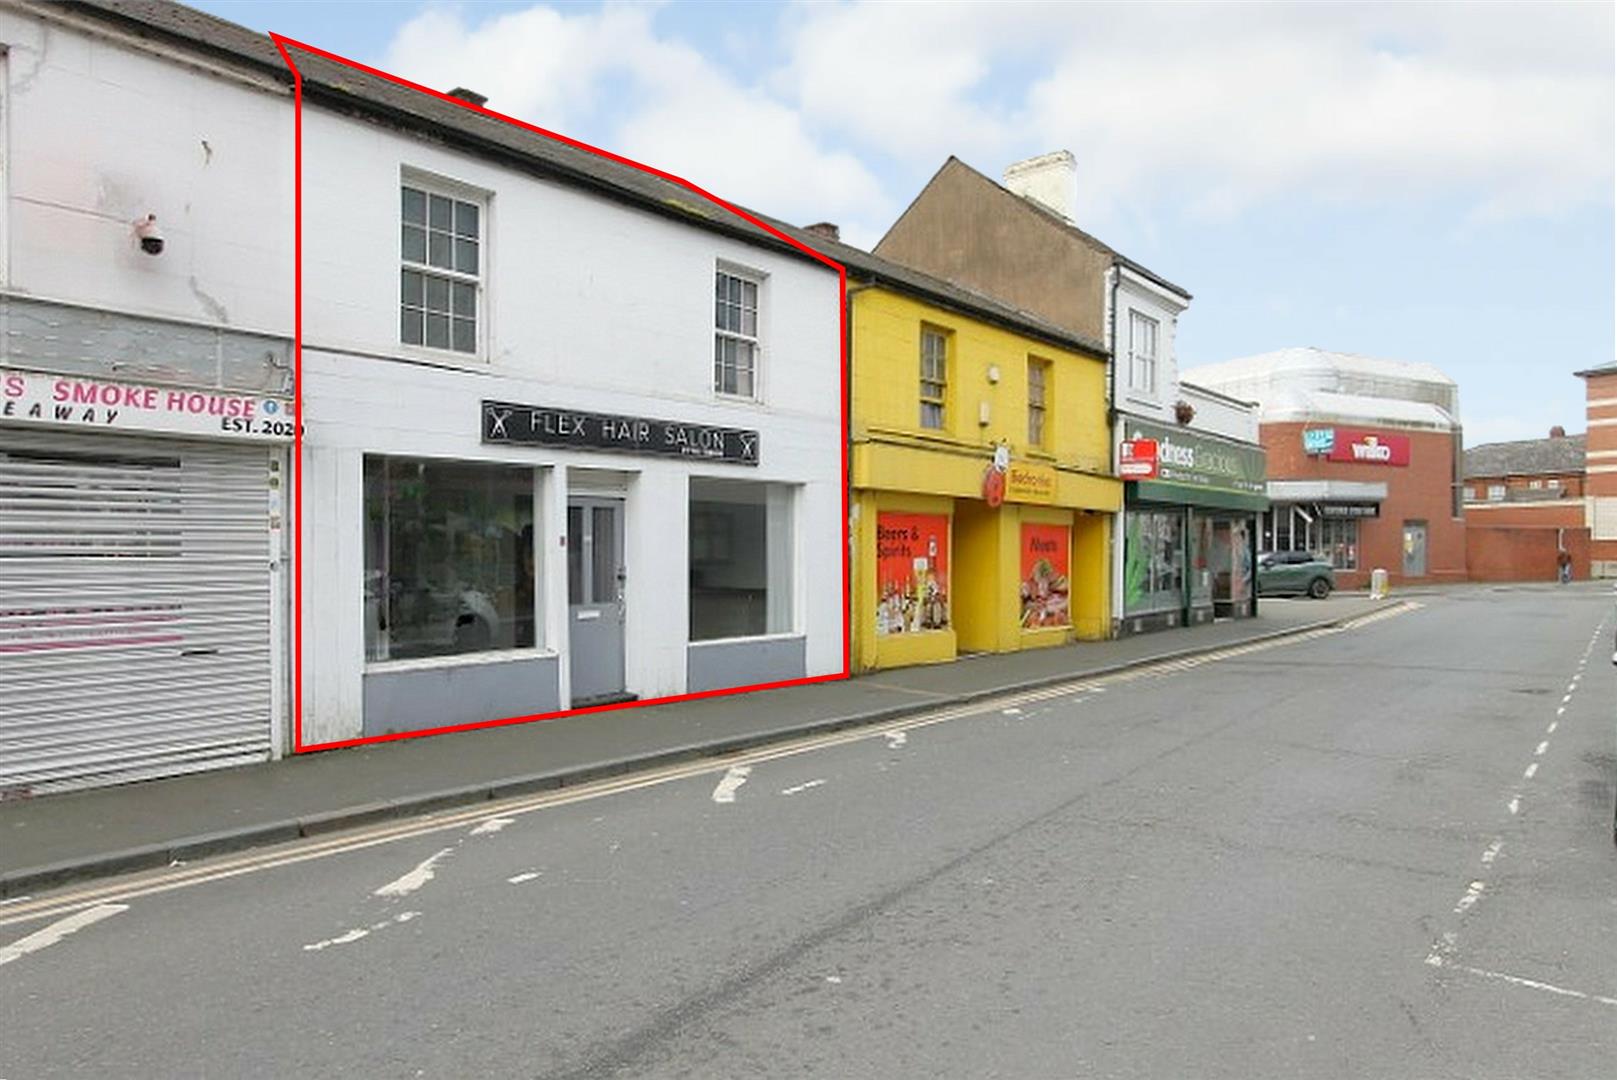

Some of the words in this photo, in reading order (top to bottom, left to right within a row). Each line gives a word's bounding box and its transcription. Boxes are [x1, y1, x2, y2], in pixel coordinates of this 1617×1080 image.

[53, 380, 158, 410] SMOKE
[167, 391, 256, 418] HOUSE
[221, 417, 258, 433] EST.
[530, 410, 589, 436] FLEX
[602, 420, 650, 442] HAIR
[664, 426, 724, 449] SALON
[1352, 436, 1391, 460] wilko
[877, 524, 908, 540] Beers
[911, 525, 919, 541] &
[877, 542, 912, 559] Spirits
